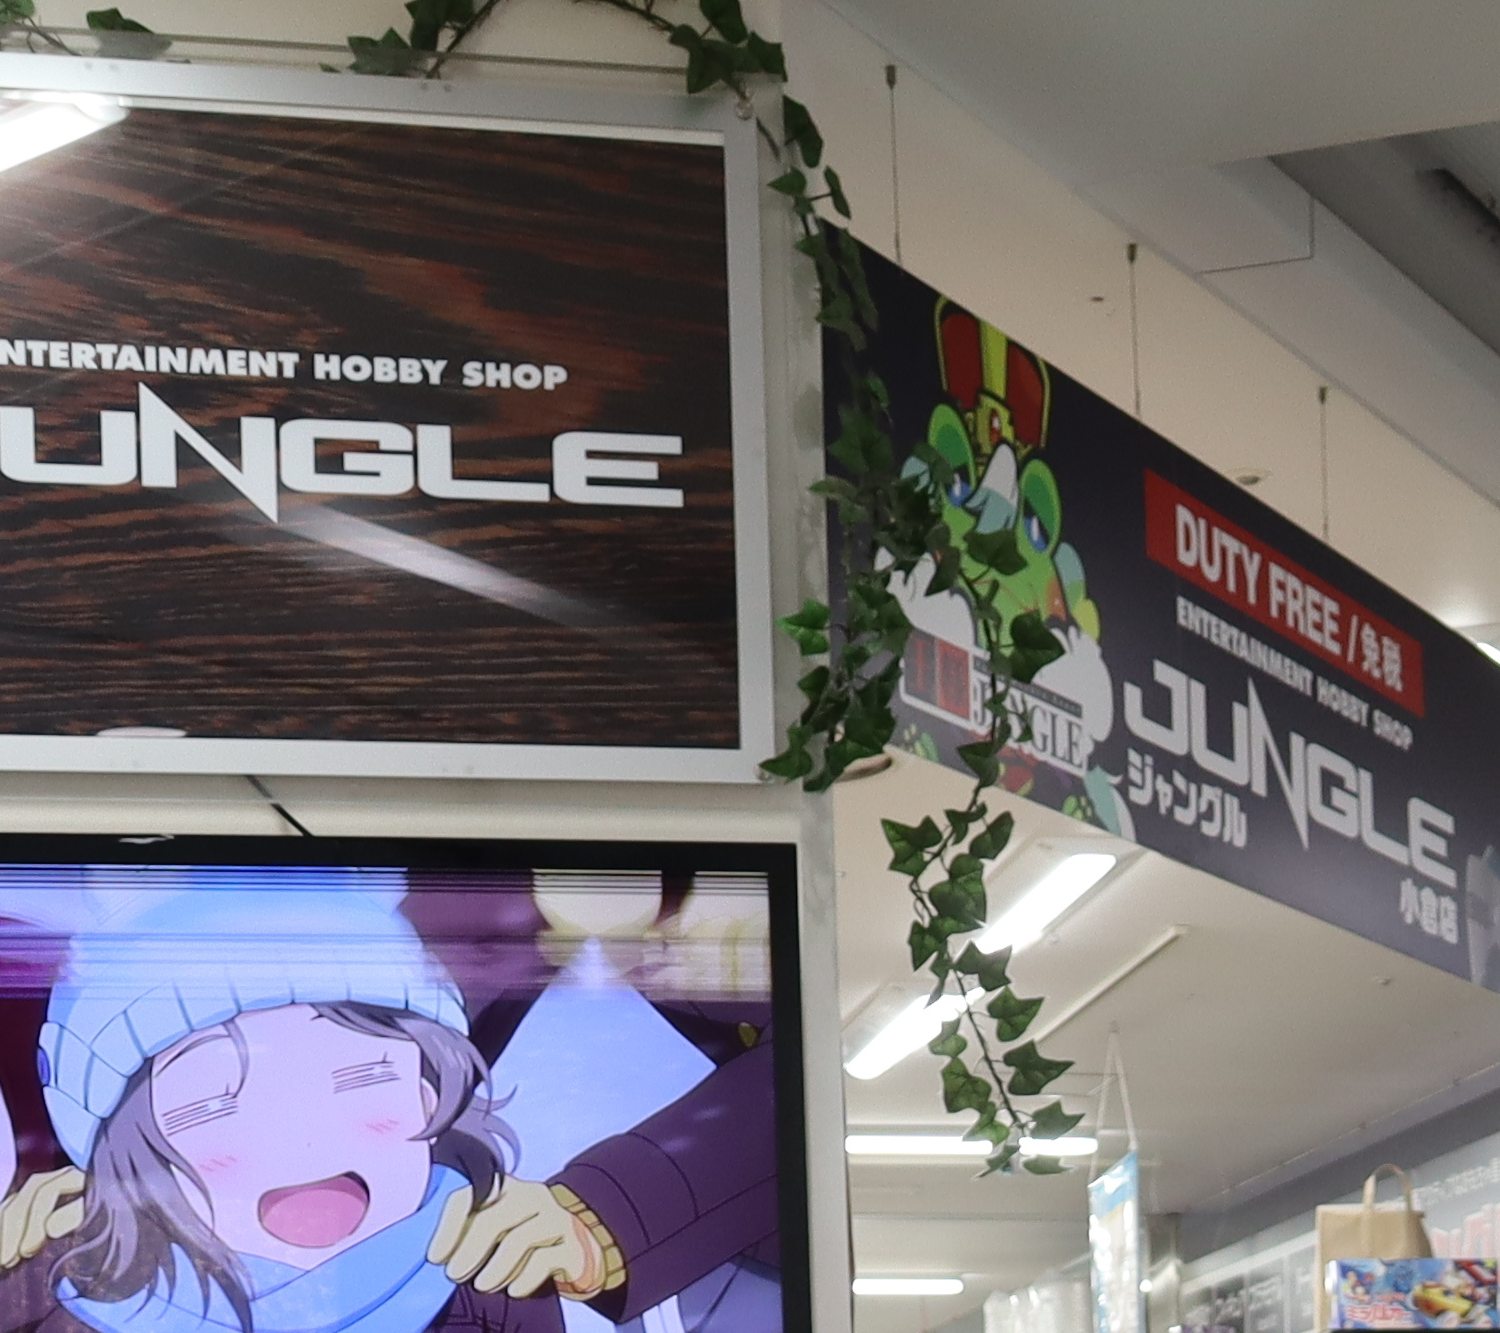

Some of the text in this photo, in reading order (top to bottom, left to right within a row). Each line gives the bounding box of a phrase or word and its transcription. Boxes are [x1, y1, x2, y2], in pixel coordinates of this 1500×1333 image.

[314, 354, 448, 388] HOBBY
[462, 360, 569, 392] SHOP
[1176, 504, 1261, 605] DUTY
[1269, 562, 1342, 656] FREE
[1177, 597, 1414, 751] ENTERTAINMENT HOBBY SHOP
[1123, 659, 1457, 889] JUNGLE
[1127, 748, 1247, 849] ジャングル
[1401, 879, 1458, 944] 小倉店
